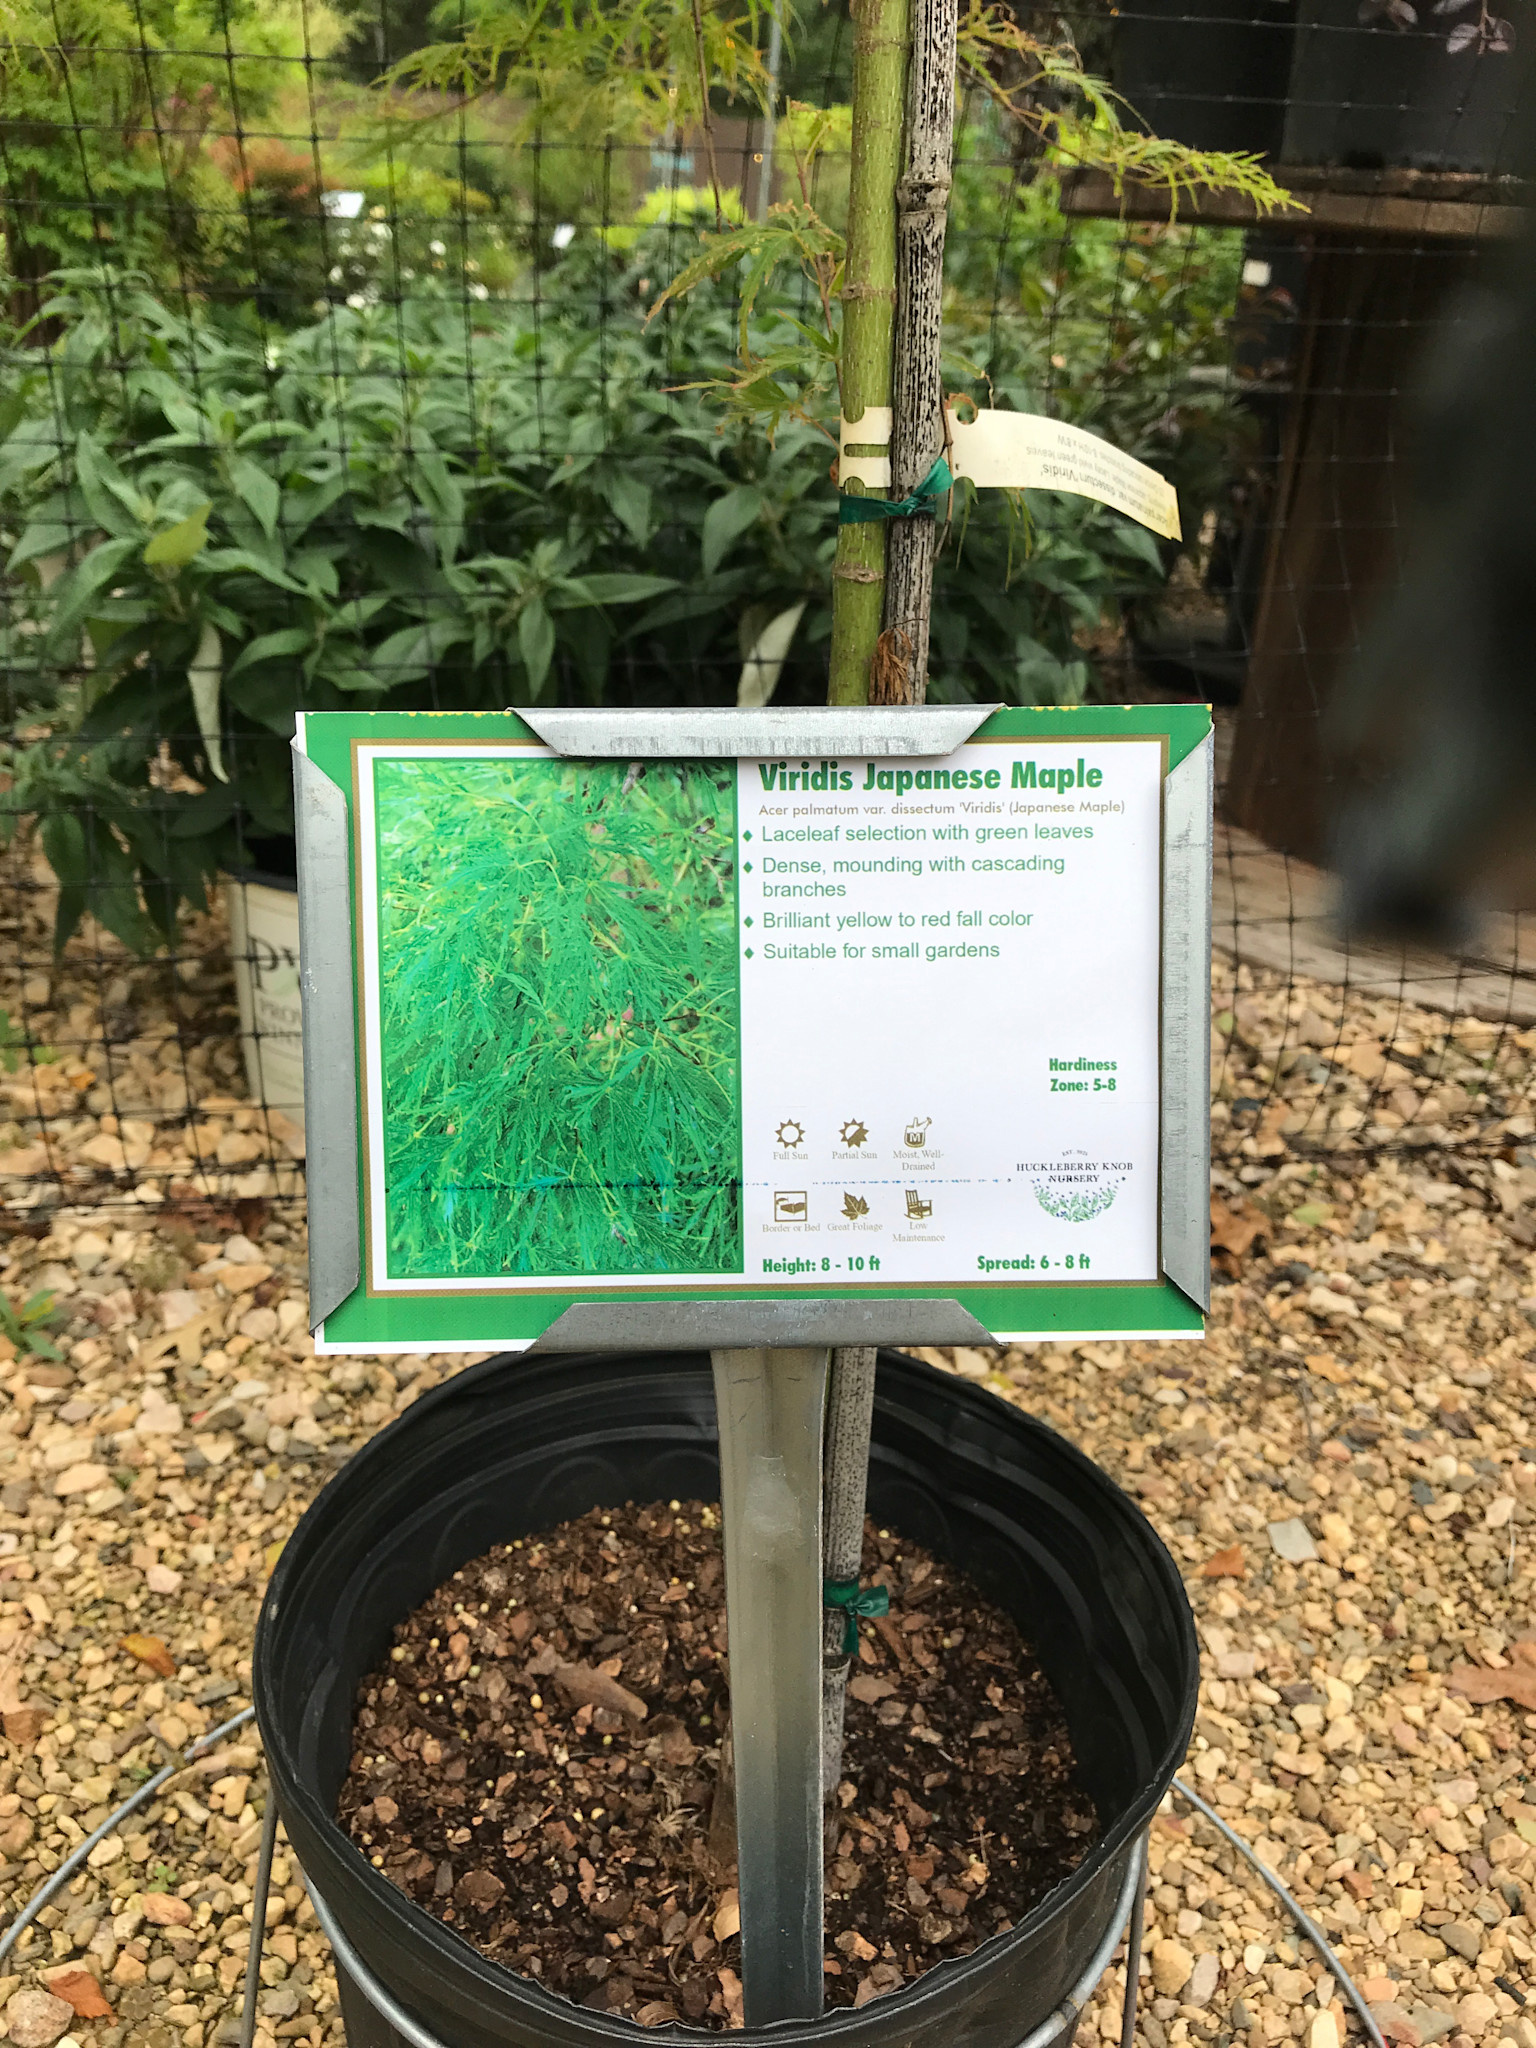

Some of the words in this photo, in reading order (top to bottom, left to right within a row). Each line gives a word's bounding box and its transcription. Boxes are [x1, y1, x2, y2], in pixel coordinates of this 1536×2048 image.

[1025, 446, 1055, 461] leaves
[757, 760, 855, 791] Viridis
[861, 759, 1001, 797] Japanese
[1010, 757, 1103, 795] Maple
[758, 804, 789, 816] Acer
[792, 803, 859, 819] palmatum
[863, 805, 887, 816] var.
[890, 802, 955, 815] dissectum
[959, 801, 1005, 814] 'Viridis'
[1009, 801, 1075, 817] (Japanese
[1079, 799, 1125, 815] Maple)
[762, 824, 841, 842] Laceleaf
[845, 824, 927, 842] selection
[932, 824, 969, 841] with
[975, 827, 1028, 844] green
[1034, 823, 1094, 840] leaves
[762, 857, 826, 875] Dense,
[833, 856, 923, 877] mounding
[928, 855, 966, 872] with
[971, 854, 1065, 875] cascading
[763, 880, 847, 898] branches
[763, 911, 831, 929] Brilliant
[836, 911, 893, 932] yellow
[897, 911, 916, 928] to
[921, 910, 951, 927] red
[956, 910, 983, 927] fall
[988, 910, 1034, 927] color
[763, 942, 837, 960] Suitable
[842, 942, 867, 959] for
[871, 942, 920, 959] small
[925, 941, 1000, 962] gardens
[1048, 1056, 1118, 1072] Hardiness
[1050, 1078, 1089, 1092] Zone:
[1092, 1077, 1117, 1092] 5-8
[772, 1151, 789, 1161] Full
[791, 1151, 809, 1160] Sun
[831, 1150, 859, 1160] Partial
[860, 1150, 878, 1160] Sun
[892, 1150, 920, 1159] Moist,
[921, 1149, 945, 1159] Well-
[901, 1161, 936, 1171] Drained
[1016, 1162, 1099, 1172] HUCKLEBERRY
[1102, 1162, 1133, 1171] KNOB
[1048, 1174, 1098, 1183] NURSERY
[762, 1223, 791, 1233] Border
[792, 1225, 803, 1233] or
[804, 1223, 821, 1232] Bed
[827, 1223, 850, 1231] Great
[853, 1222, 883, 1233] Foliage
[909, 1221, 929, 1231] Low
[892, 1233, 946, 1242] Maintenance
[762, 1256, 817, 1276] Height:
[820, 1256, 831, 1272] 8
[847, 1256, 865, 1272] 10
[868, 1255, 881, 1271] ft
[977, 1254, 1036, 1273] Spread:
[1039, 1255, 1050, 1270] 6
[1064, 1254, 1075, 1270] 8
[1078, 1253, 1091, 1270] ft
